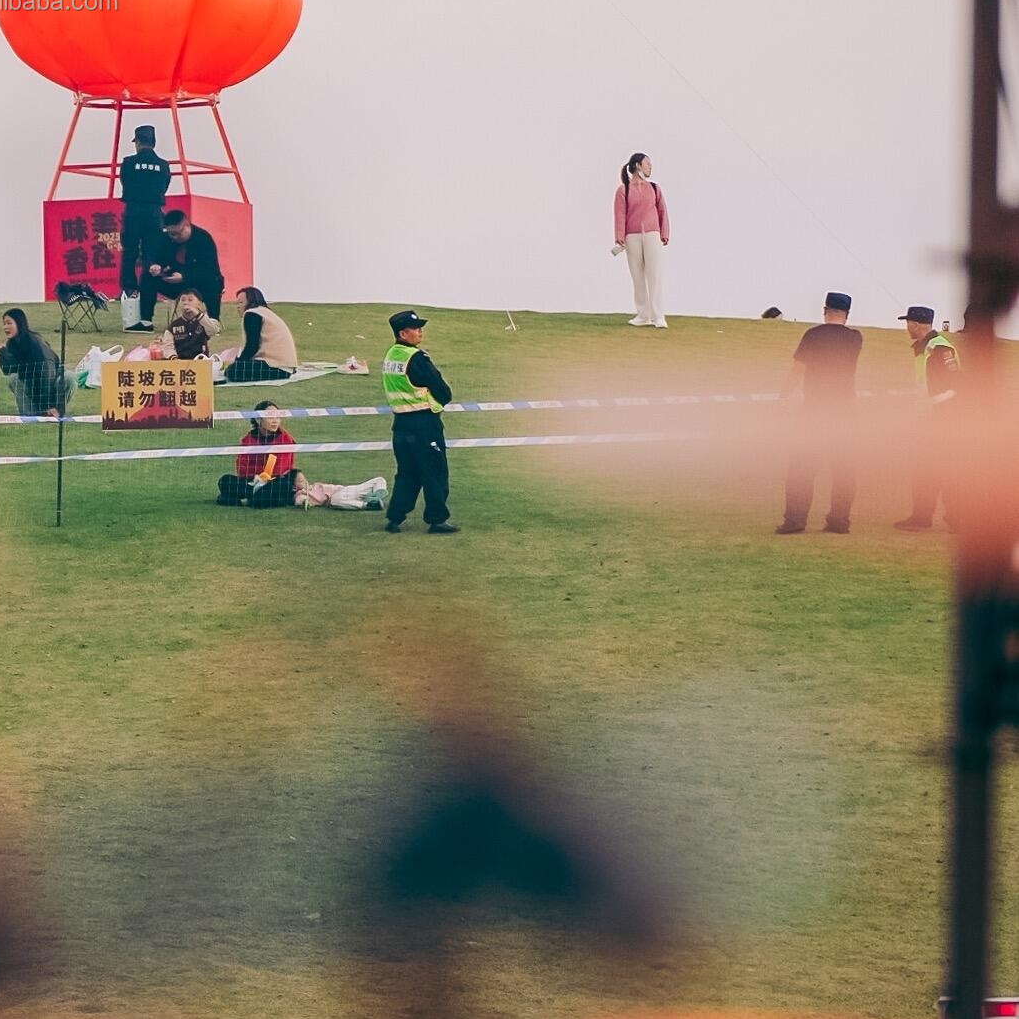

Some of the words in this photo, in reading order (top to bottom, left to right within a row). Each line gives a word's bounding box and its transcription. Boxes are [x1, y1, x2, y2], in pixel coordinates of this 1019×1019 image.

[118, 369, 197, 387] 陡坡危险
[118, 390, 197, 408] 请勿翻越
